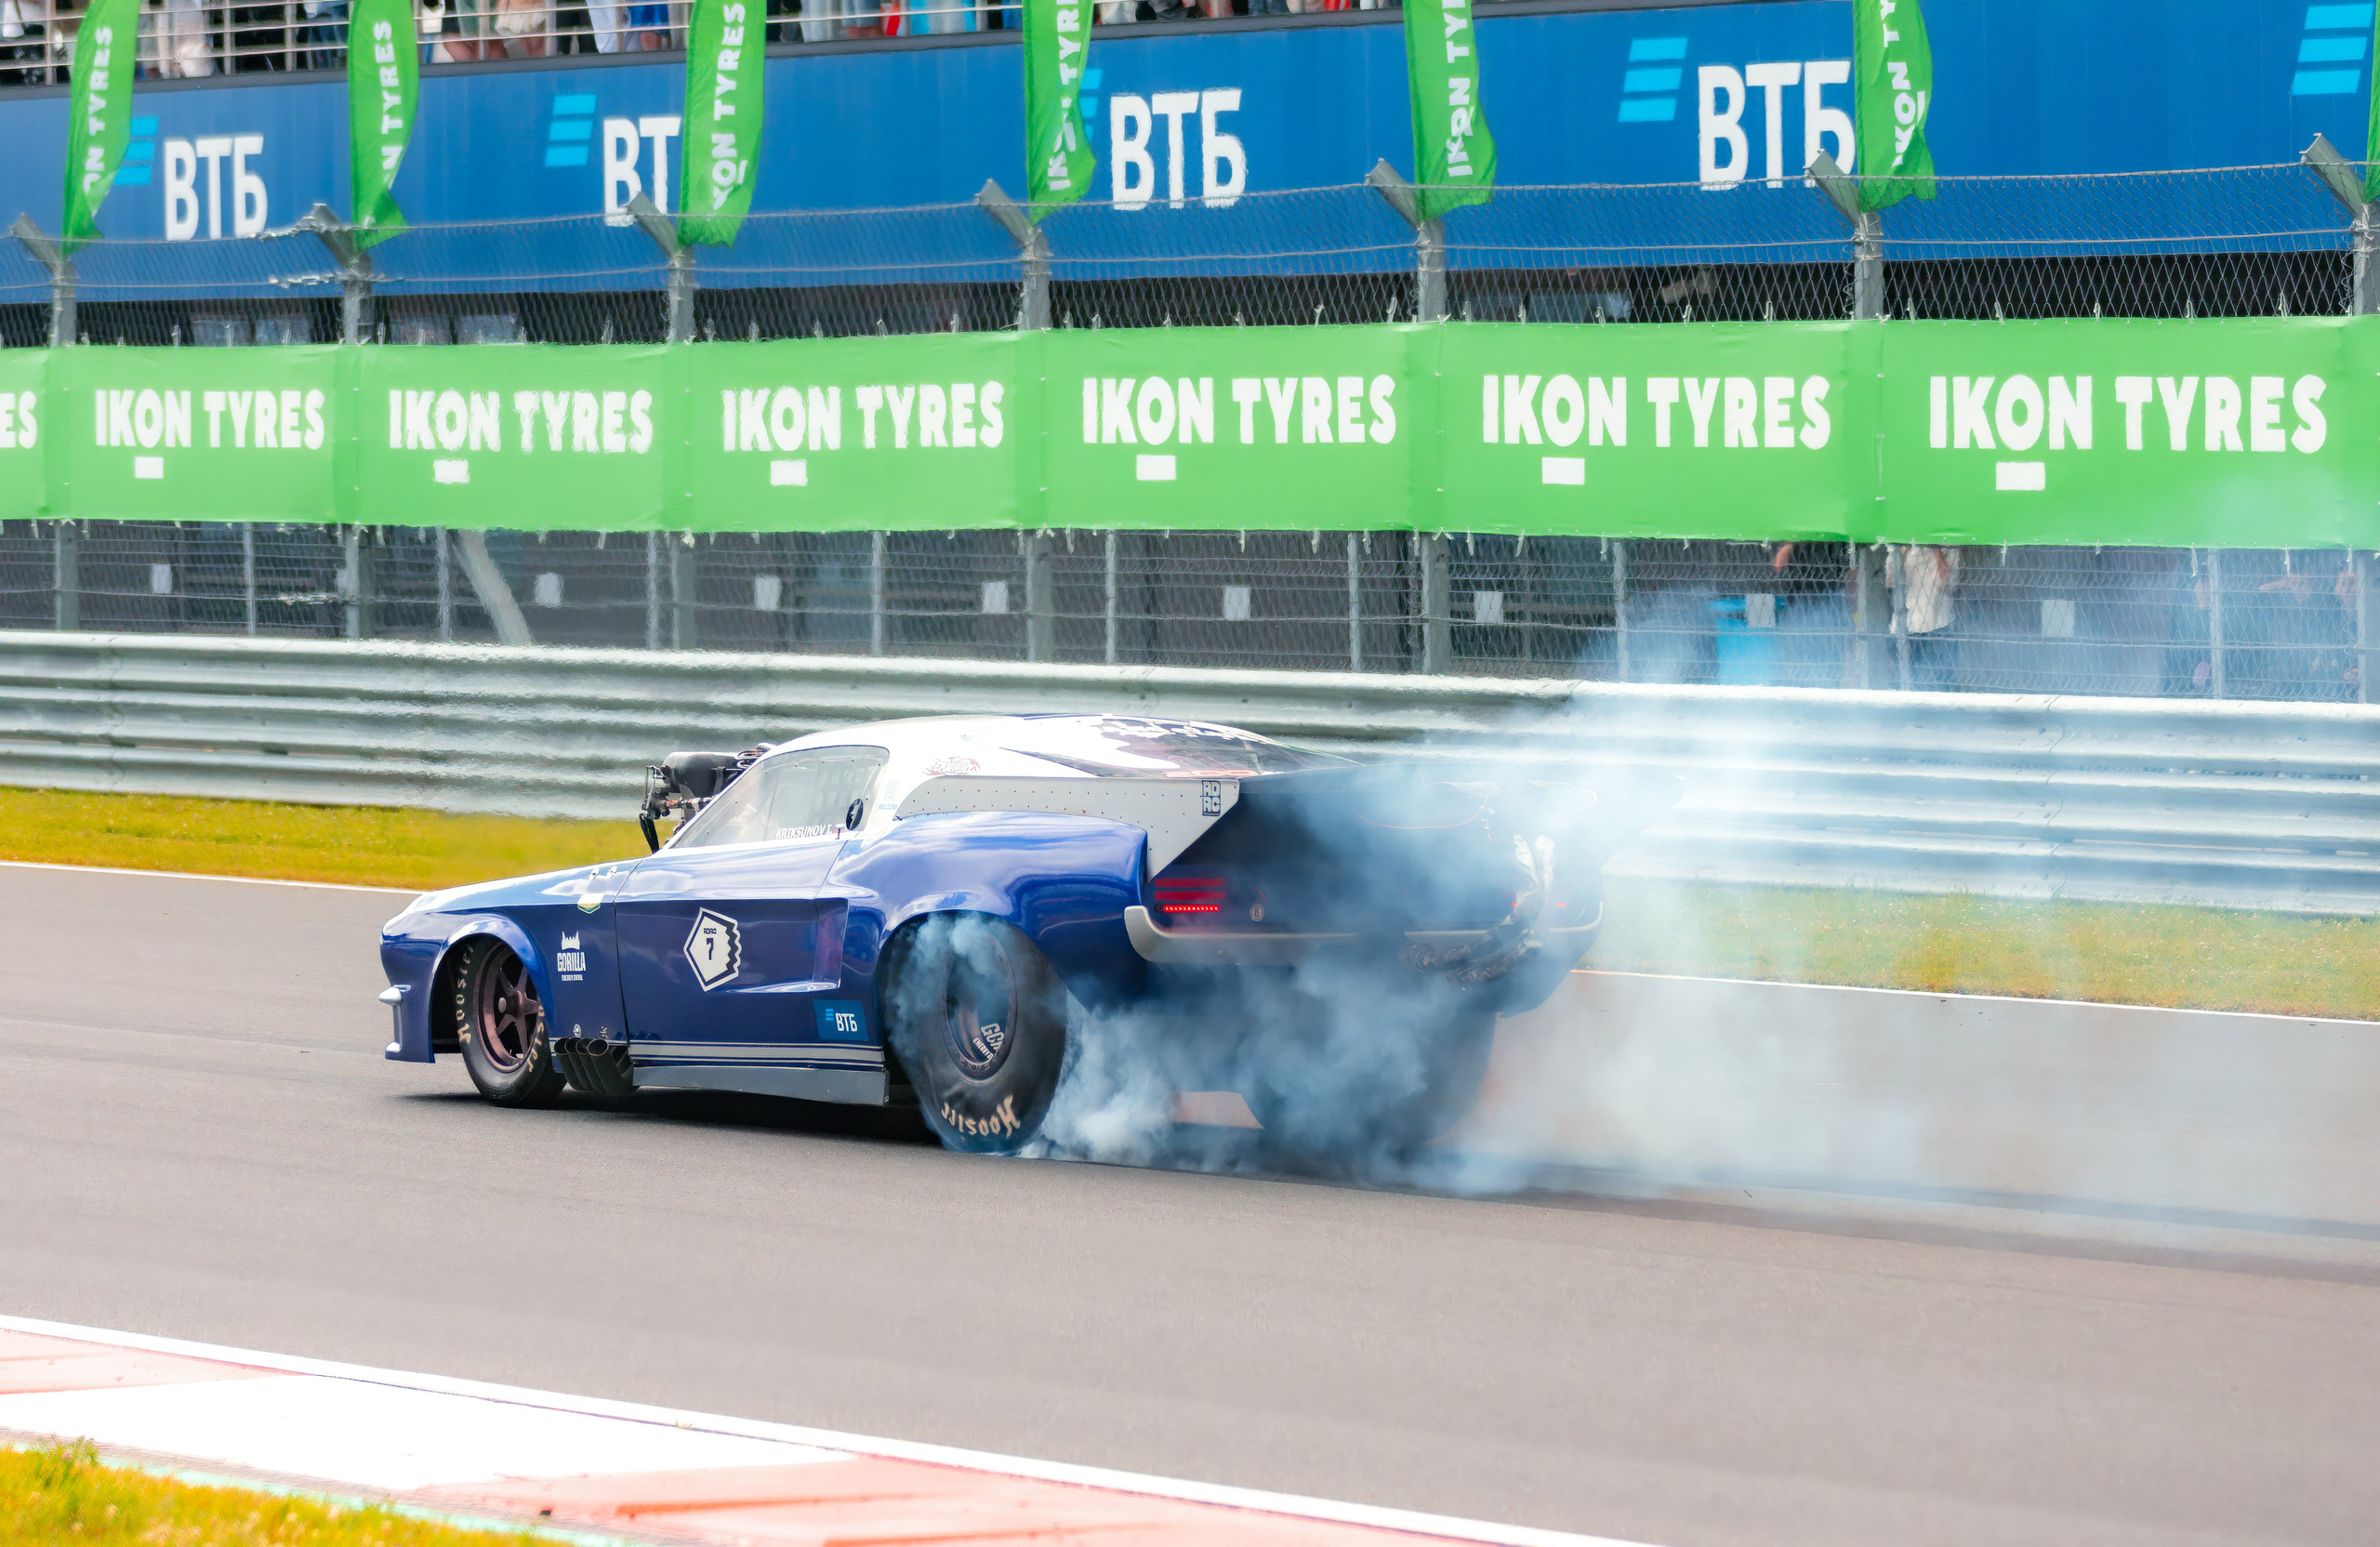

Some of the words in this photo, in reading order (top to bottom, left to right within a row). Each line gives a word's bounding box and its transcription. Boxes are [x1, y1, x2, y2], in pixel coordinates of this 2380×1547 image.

[89, 27, 112, 135] TYRES
[374, 22, 403, 135] TYRES
[714, 4, 746, 121] TYRES
[1110, 88, 1248, 211] ВТБ
[1699, 60, 1856, 192] ВТБ
[165, 135, 269, 242] ВТБ
[603, 116, 681, 227] ВТ
[95, 387, 192, 449] IKON
[203, 388, 326, 451] TYRES
[389, 387, 502, 453] IKON
[513, 389, 654, 455] TYRES
[721, 384, 841, 453] IKON
[855, 379, 1005, 450] TYRES
[1082, 375, 1215, 446] IKON
[1232, 373, 1397, 445] TYRES
[1483, 374, 1628, 447] IKON
[1646, 374, 1831, 450] TYRES
[1929, 374, 2094, 452] IKON
[2114, 374, 2328, 455] TYRES
[557, 951, 587, 972] GORILLA
[706, 937, 714, 960] 7
[835, 1012, 858, 1032] ВТБ
